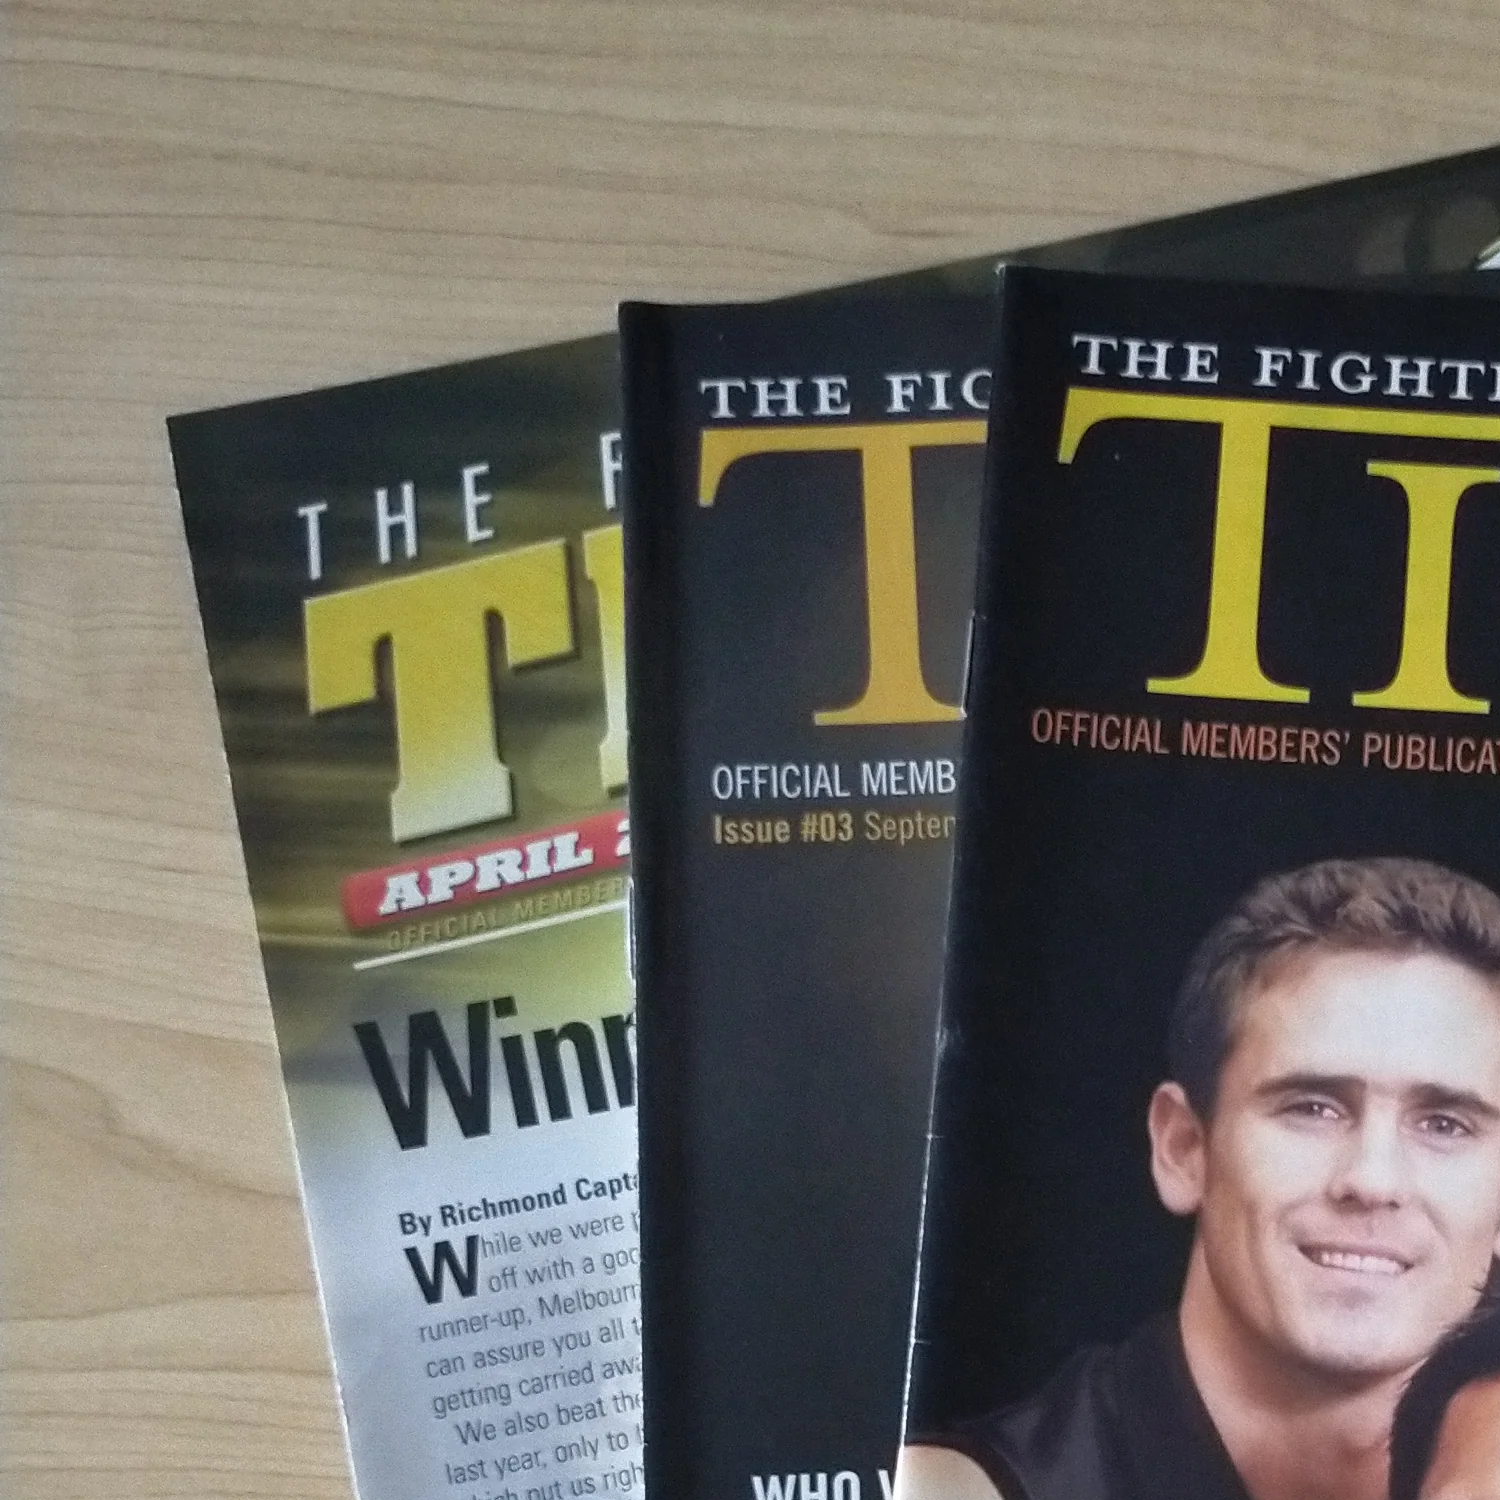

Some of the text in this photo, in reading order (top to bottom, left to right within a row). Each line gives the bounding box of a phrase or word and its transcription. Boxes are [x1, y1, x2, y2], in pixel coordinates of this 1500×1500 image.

[1072, 333, 1221, 386] THE
[701, 375, 850, 419] THE
[299, 462, 493, 580] THE
[1031, 708, 1170, 756] OFFICIAL
[1181, 721, 1350, 766] MEMBERS'
[712, 759, 956, 800] OFFICIAL MEMB
[714, 814, 790, 845] Issue
[800, 812, 853, 843] #03
[378, 831, 594, 916] APRIL
[399, 1211, 433, 1238] By
[440, 1184, 568, 1228] Richmond
[528, 1224, 563, 1248] we
[569, 1213, 625, 1241] were
[488, 1264, 516, 1293] off
[524, 1257, 575, 1291] with
[582, 1255, 595, 1274] a
[419, 1308, 533, 1343] runner-up,
[426, 1354, 465, 1379] can
[473, 1337, 545, 1369] assure
[552, 1329, 592, 1359] you
[600, 1317, 626, 1344] all
[433, 1381, 510, 1420] getting
[519, 1363, 594, 1398] carried
[455, 1420, 497, 1447] We
[504, 1410, 550, 1437] also
[557, 1396, 608, 1426] beat
[446, 1458, 488, 1486] last
[555, 1434, 600, 1463] only
[606, 1429, 630, 1452] to
[571, 1475, 597, 1498] us
